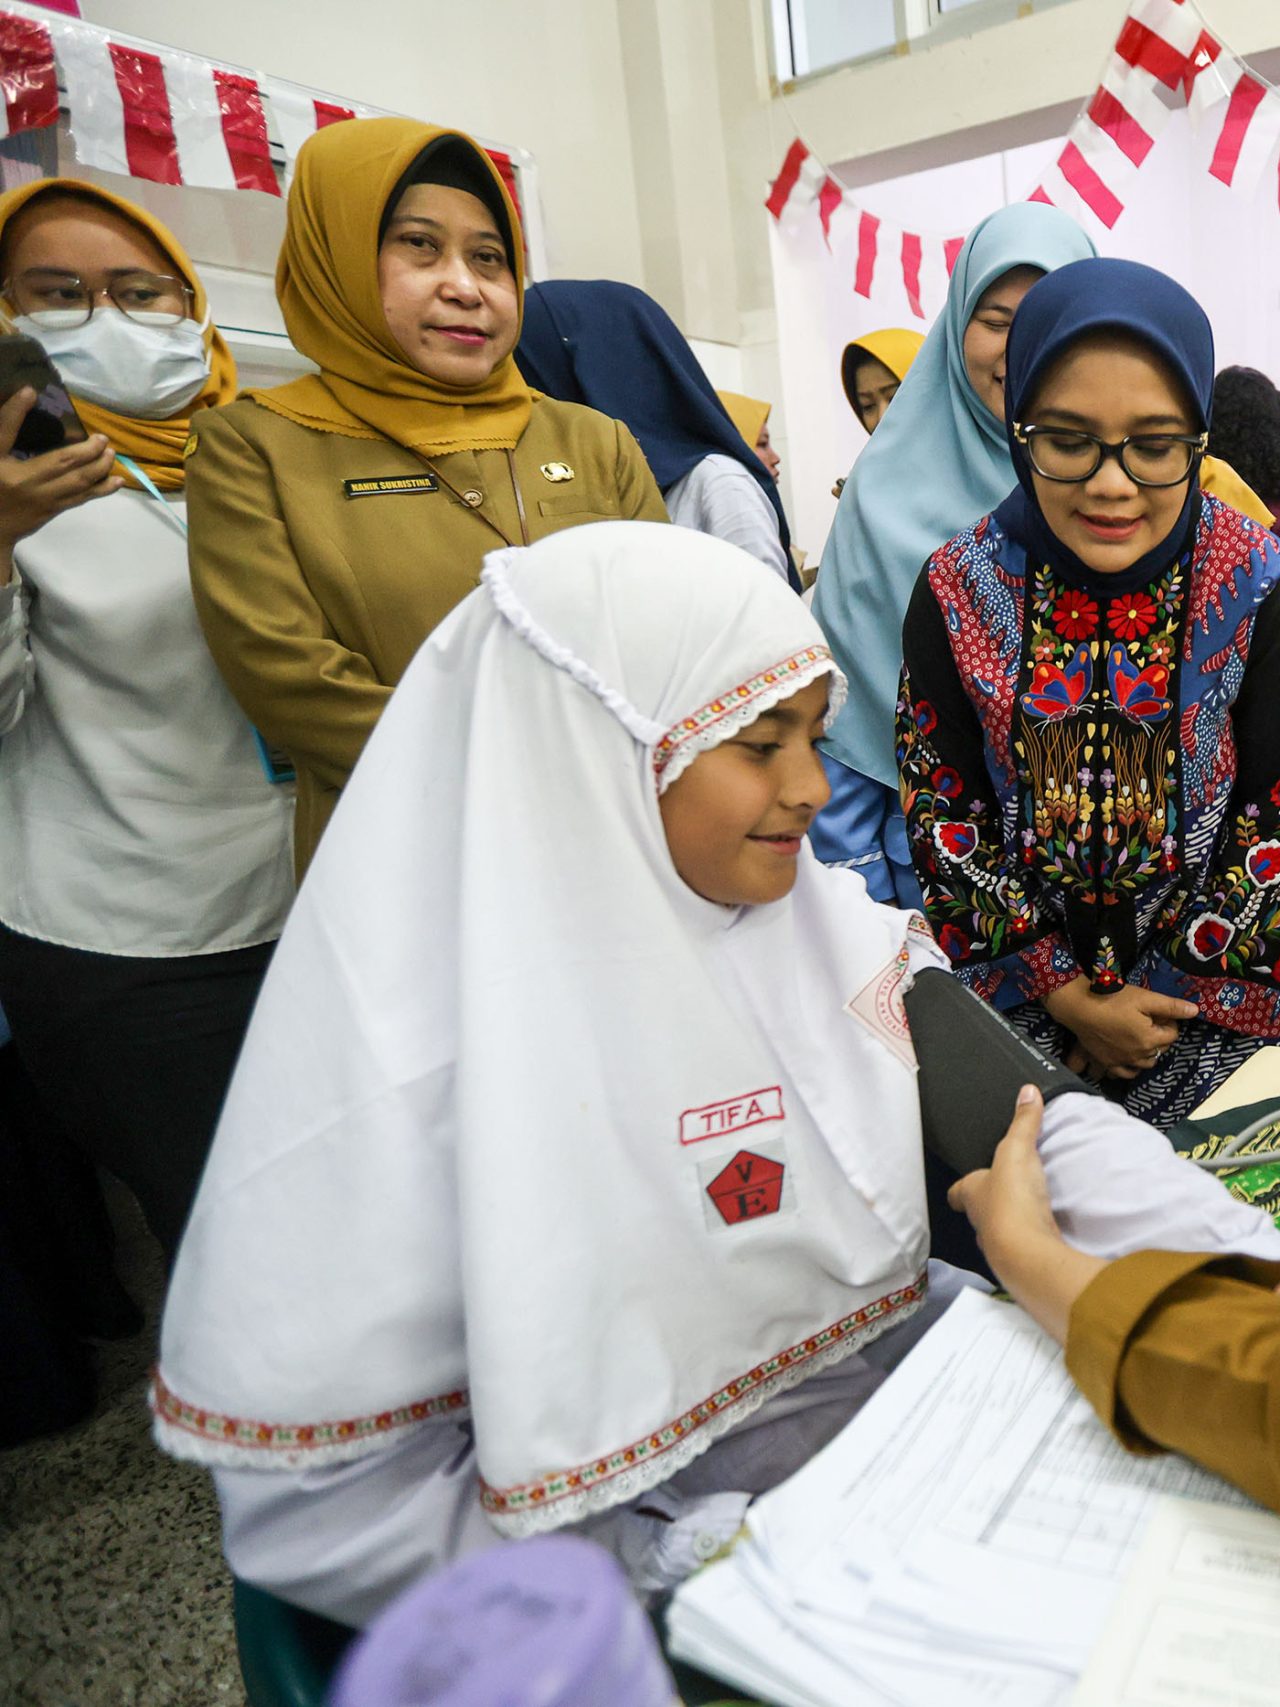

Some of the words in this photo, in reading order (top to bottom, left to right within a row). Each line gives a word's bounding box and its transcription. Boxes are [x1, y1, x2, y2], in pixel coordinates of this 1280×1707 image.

[351, 483, 379, 491] NANIK
[379, 479, 431, 489] SUKRISTINA
[700, 1098, 764, 1131] TIFA
[735, 1160, 753, 1183] V
[736, 1188, 767, 1218] E
